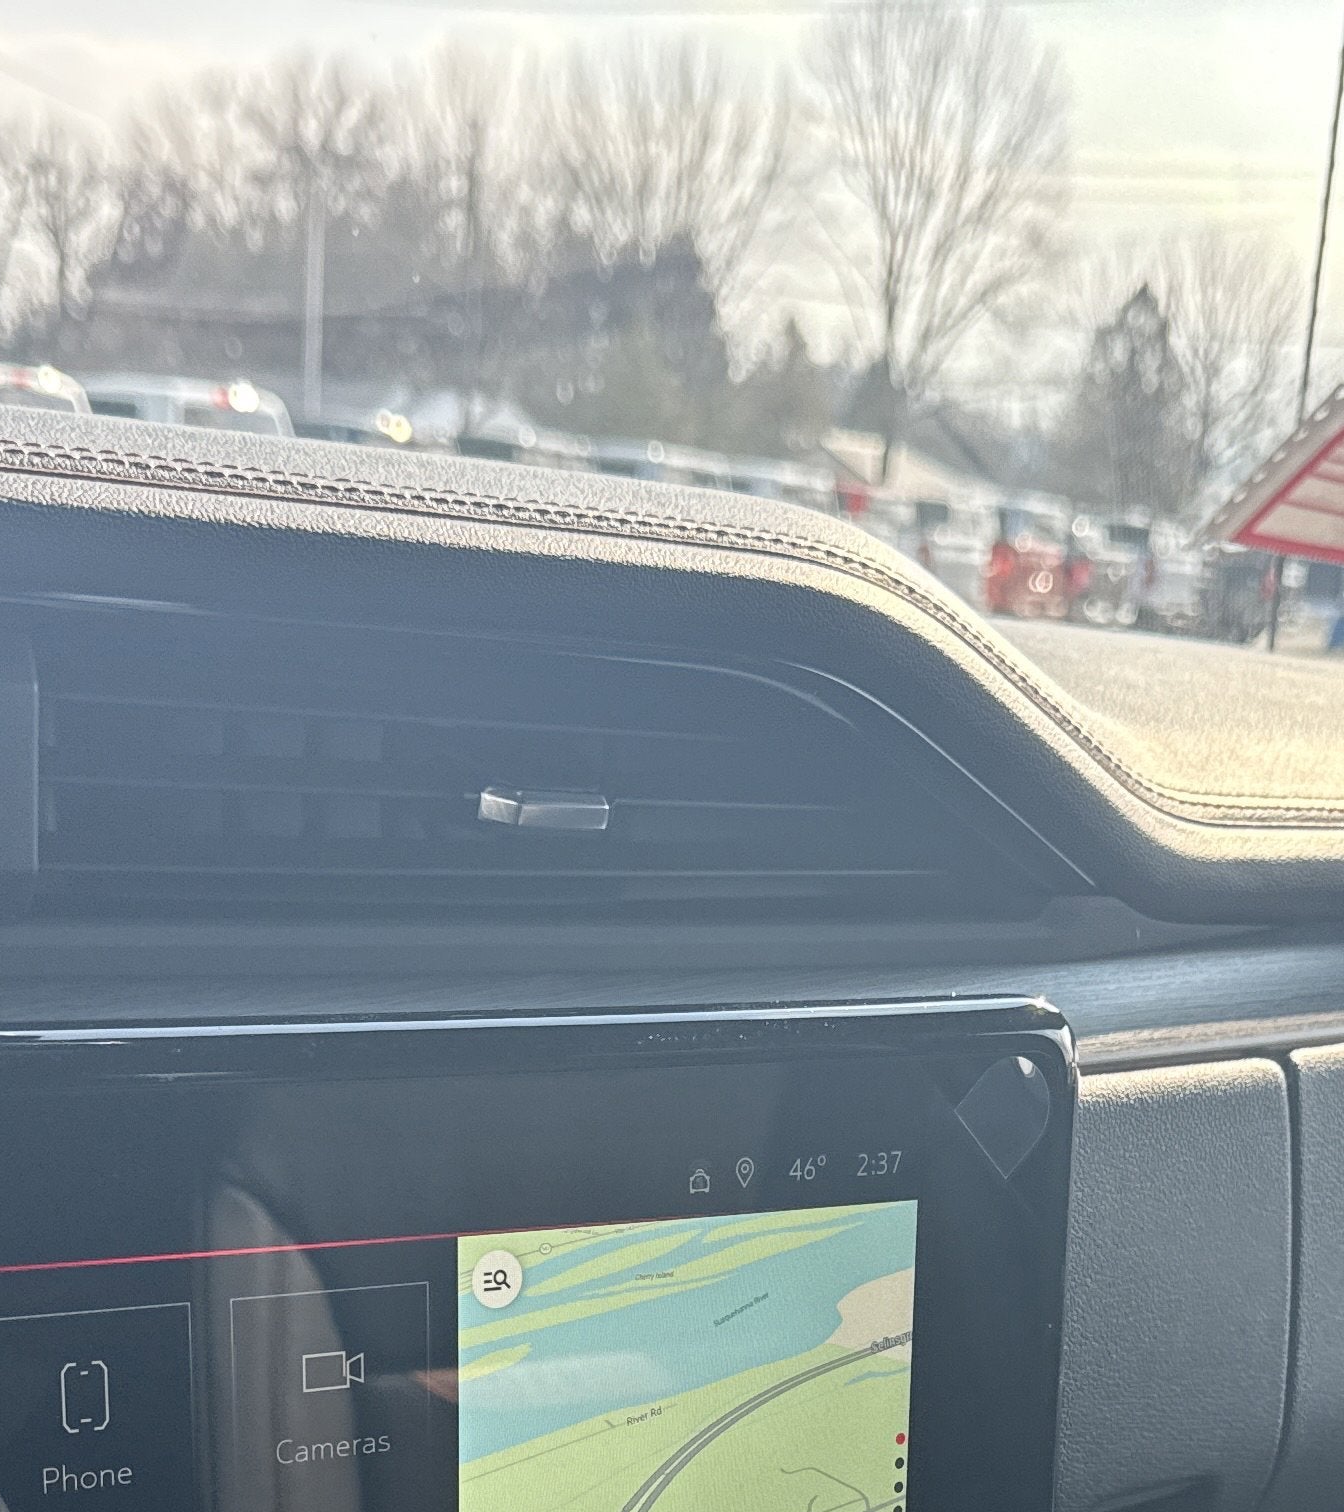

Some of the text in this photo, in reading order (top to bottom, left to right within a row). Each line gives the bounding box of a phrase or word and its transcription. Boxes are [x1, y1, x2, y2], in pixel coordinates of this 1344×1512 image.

[856, 1150, 903, 1177] 2:37
[626, 1405, 663, 1427] River Rd
[275, 1430, 391, 1466] Cameras
[42, 1463, 134, 1495] Phone
